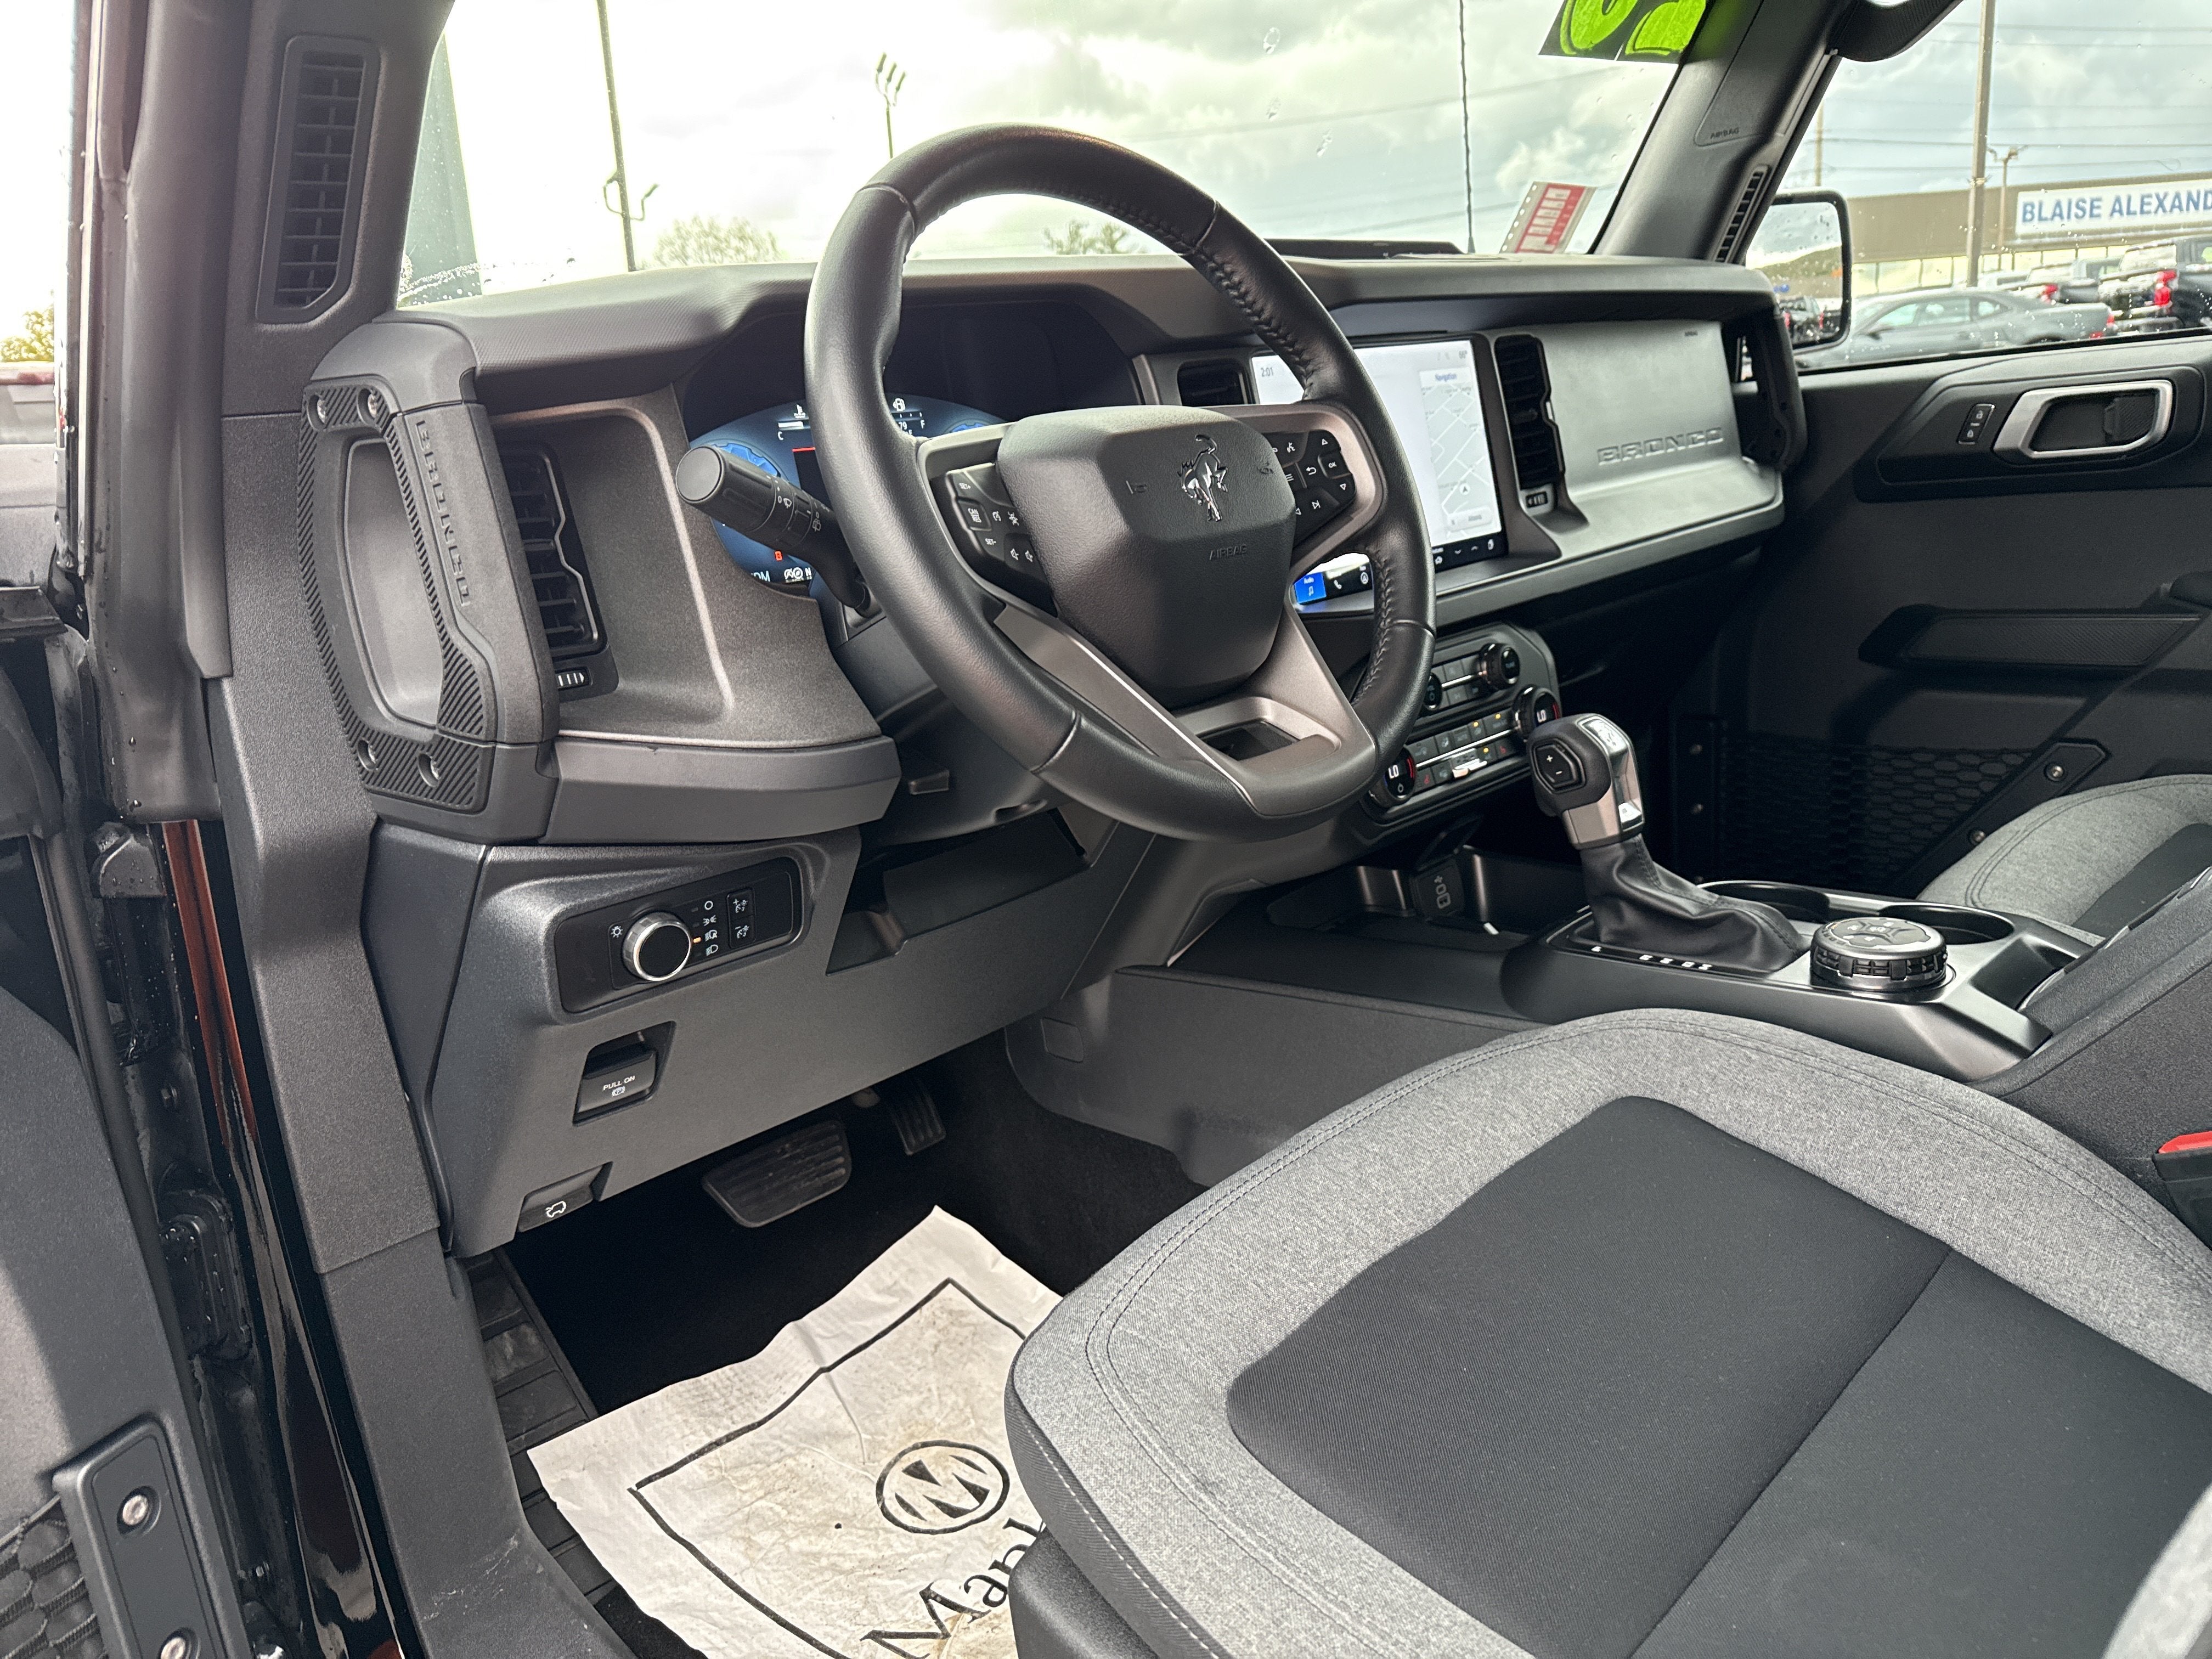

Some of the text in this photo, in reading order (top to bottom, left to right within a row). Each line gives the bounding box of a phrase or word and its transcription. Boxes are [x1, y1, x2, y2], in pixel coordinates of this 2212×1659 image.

[2022, 196, 2102, 224] BLAISE
[1261, 367, 1274, 377] 2:01
[1597, 427, 1724, 466] BRONCO
[415, 420, 471, 607] BRONCO
[1209, 544, 1248, 560] AIRBAG
[1537, 709, 1547, 723] LO
[1387, 764, 1400, 779] LO
[602, 1075, 635, 1091] PULL ON
